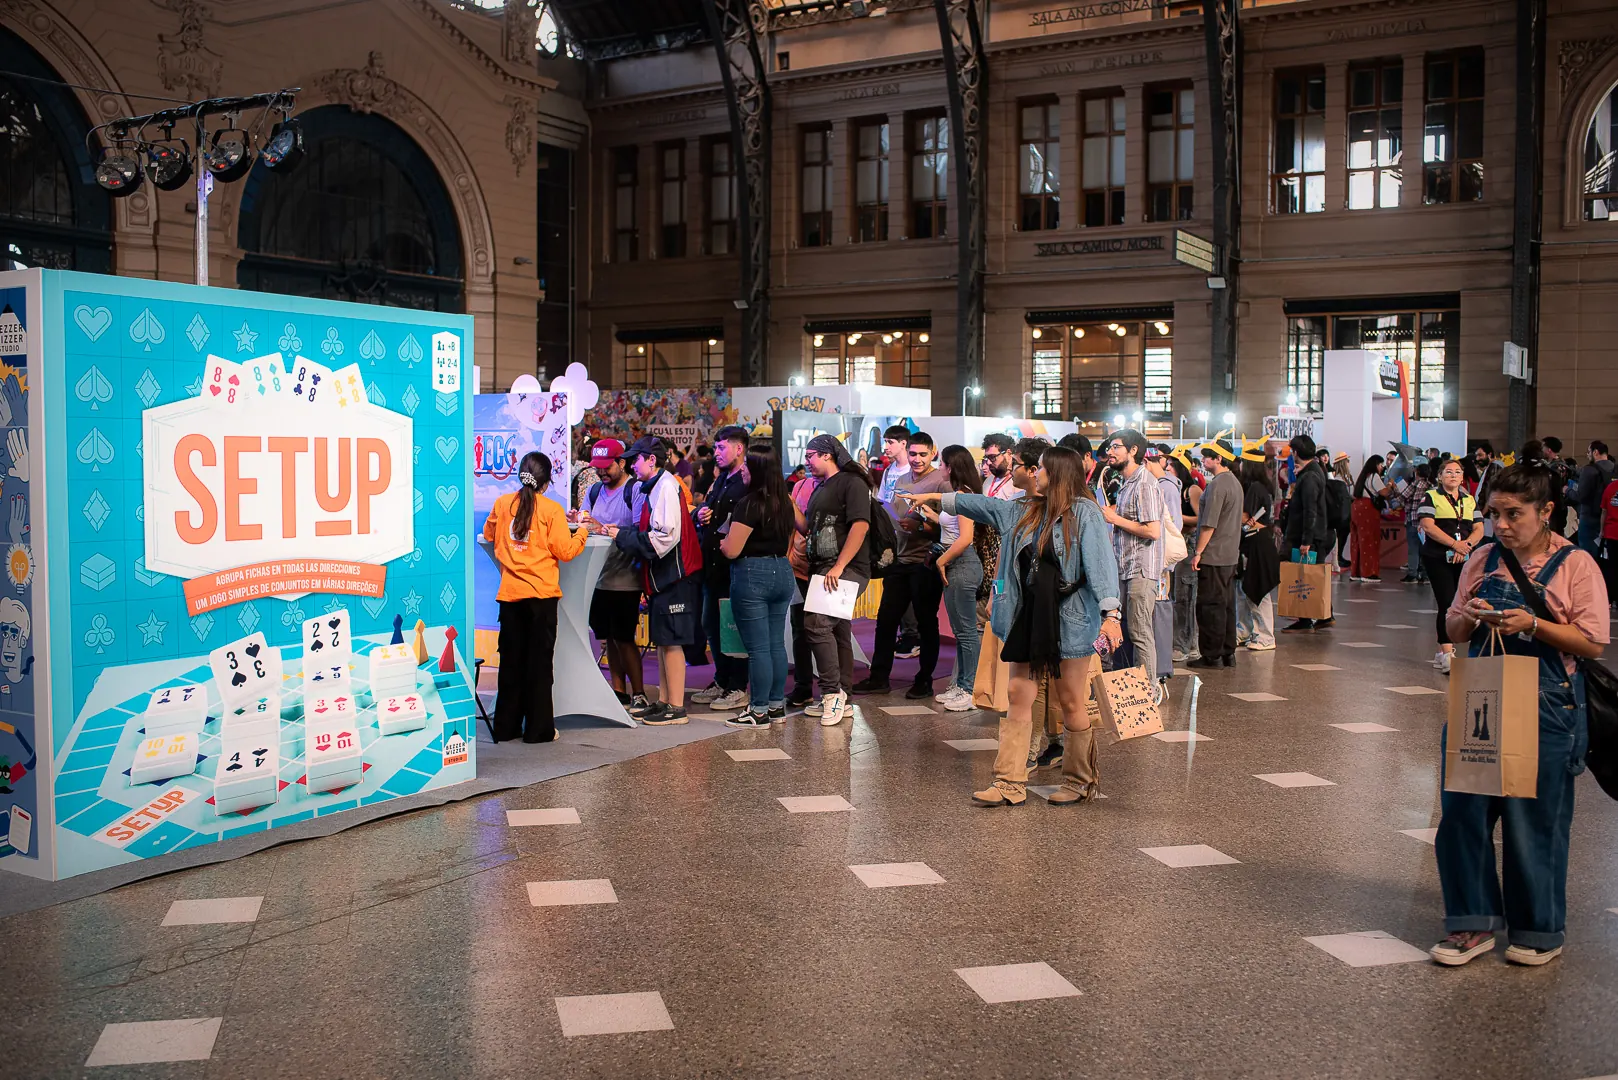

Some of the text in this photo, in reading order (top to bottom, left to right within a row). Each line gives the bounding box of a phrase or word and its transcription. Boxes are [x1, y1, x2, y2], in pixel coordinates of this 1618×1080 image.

[1032, 0, 1151, 25] SALA ANA GONZA
[1327, 19, 1426, 42] VALDIVIA
[1039, 60, 1076, 75] SAN
[1038, 243, 1069, 255] SALA
[1073, 239, 1122, 253] CAMILO
[1127, 236, 1165, 250] MORI
[0, 324, 23, 333] EZZER
[1, 334, 23, 343] IZZER
[447, 358, 458, 368] 2-4
[214, 366, 222, 382] 8
[253, 366, 262, 381] 8
[298, 366, 306, 382] 8
[273, 377, 281, 392] 8
[227, 388, 236, 403] 8
[308, 387, 316, 402] 8
[685, 427, 695, 435] TU
[1265, 418, 1288, 439] ONE
[174, 433, 392, 545] SETUP
[1380, 528, 1400, 541] NT
[216, 563, 361, 587] AGRUPA FICHAS EN TODAS LAS DIRECCIONES
[195, 577, 379, 610] UM JOGO SIMPLES DE CONJUNTOS EM VÁRIAS DIREÇÕES!
[312, 622, 320, 638] 2
[331, 632, 340, 647] 2
[226, 651, 239, 670] 3
[317, 699, 325, 707] 3
[388, 698, 396, 706] 2
[1116, 698, 1149, 709] Fortaleza
[148, 738, 165, 750] 10
[315, 734, 331, 744] 10
[229, 752, 240, 761] 4
[106, 791, 185, 841] SETUP
